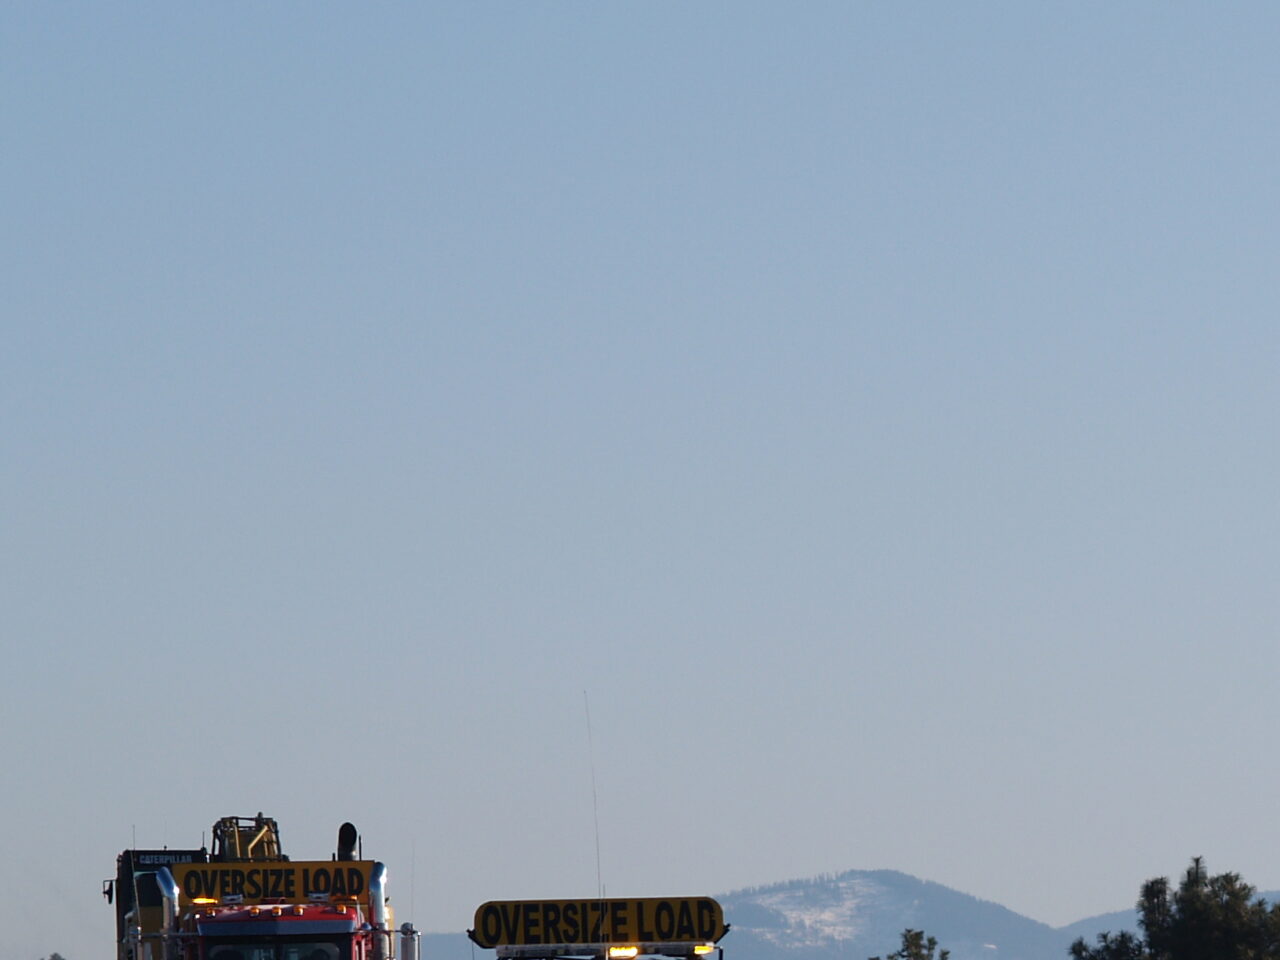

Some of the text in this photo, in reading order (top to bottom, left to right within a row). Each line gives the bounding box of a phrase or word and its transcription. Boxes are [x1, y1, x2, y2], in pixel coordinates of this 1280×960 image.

[139, 854, 193, 864] CATERPILLAR
[184, 867, 365, 899] OVERSIZE LOAD
[482, 900, 716, 945] OVERSIZE LOAD
